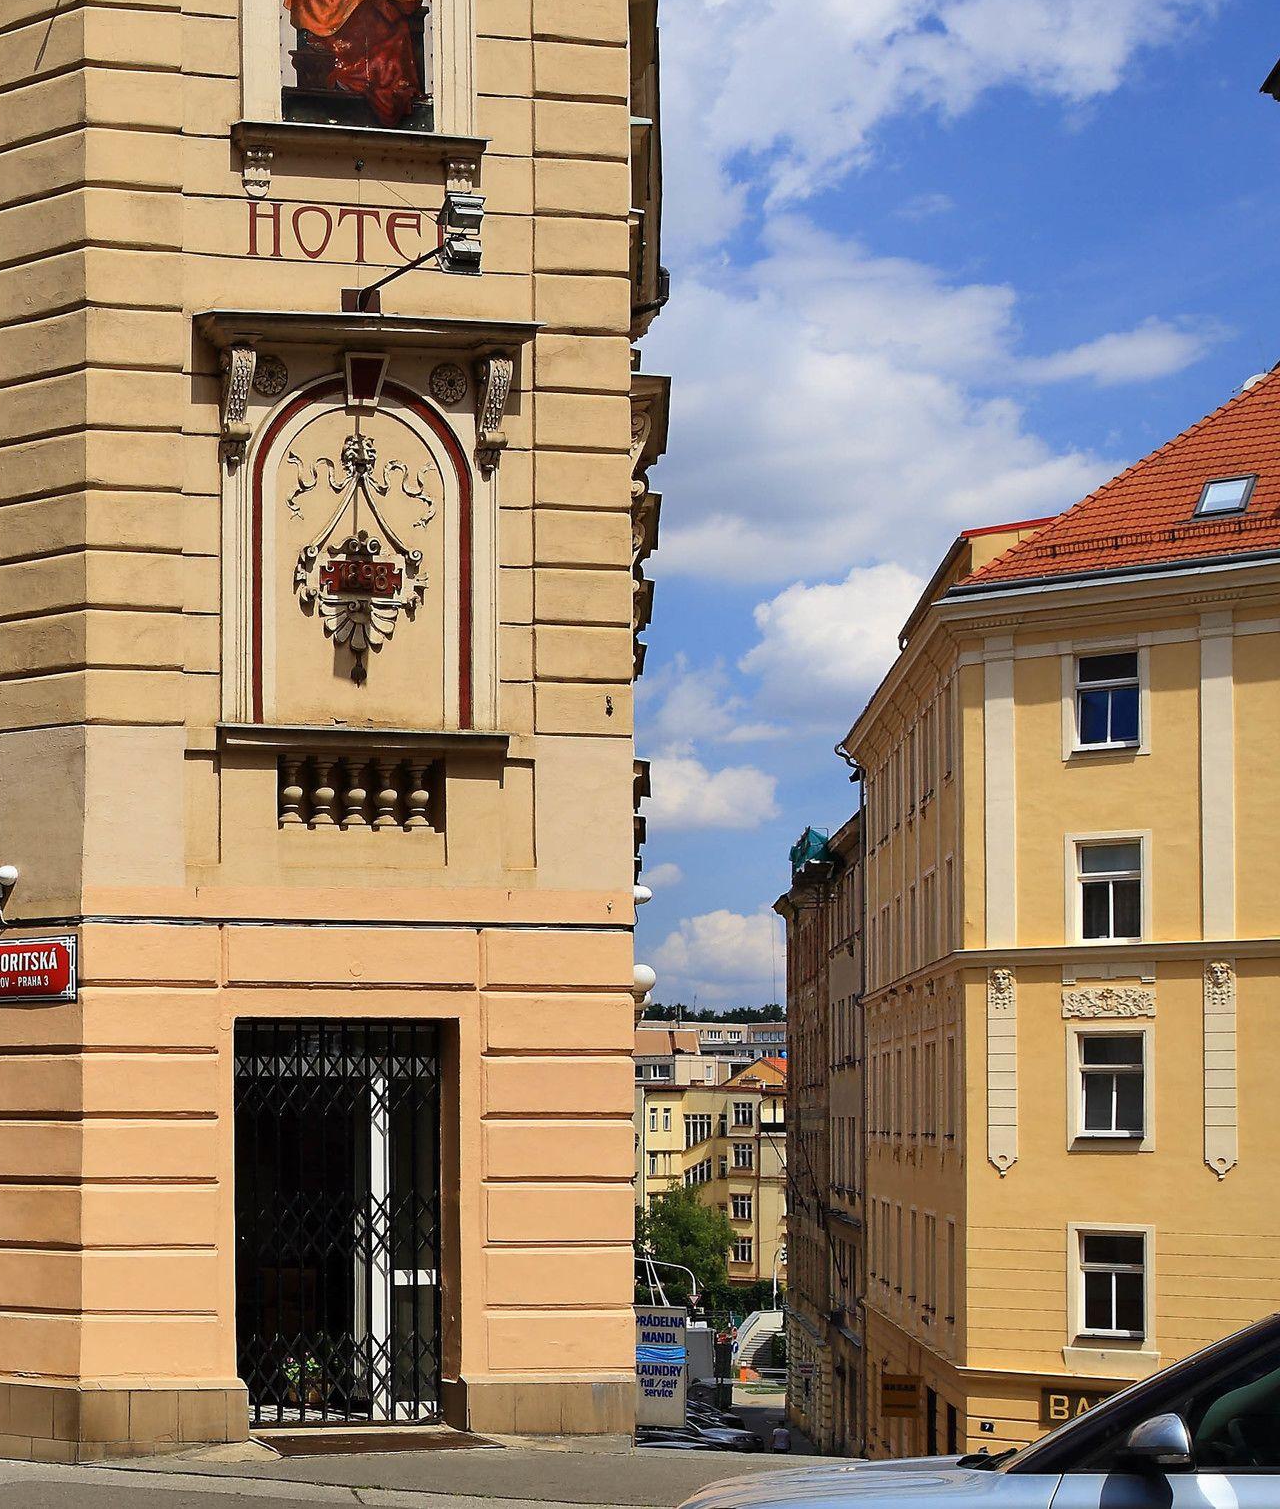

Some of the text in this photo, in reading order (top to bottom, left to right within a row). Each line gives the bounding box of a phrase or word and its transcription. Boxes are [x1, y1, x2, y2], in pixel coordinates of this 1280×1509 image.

[247, 201, 446, 268] HOTE
[340, 563, 388, 590] 1898
[17, 975, 42, 987] PRAHA
[44, 975, 49, 986] 3
[642, 1331, 677, 1343] MANDL
[636, 1365, 682, 1377] LAUNDRY
[644, 1389, 673, 1397] service
